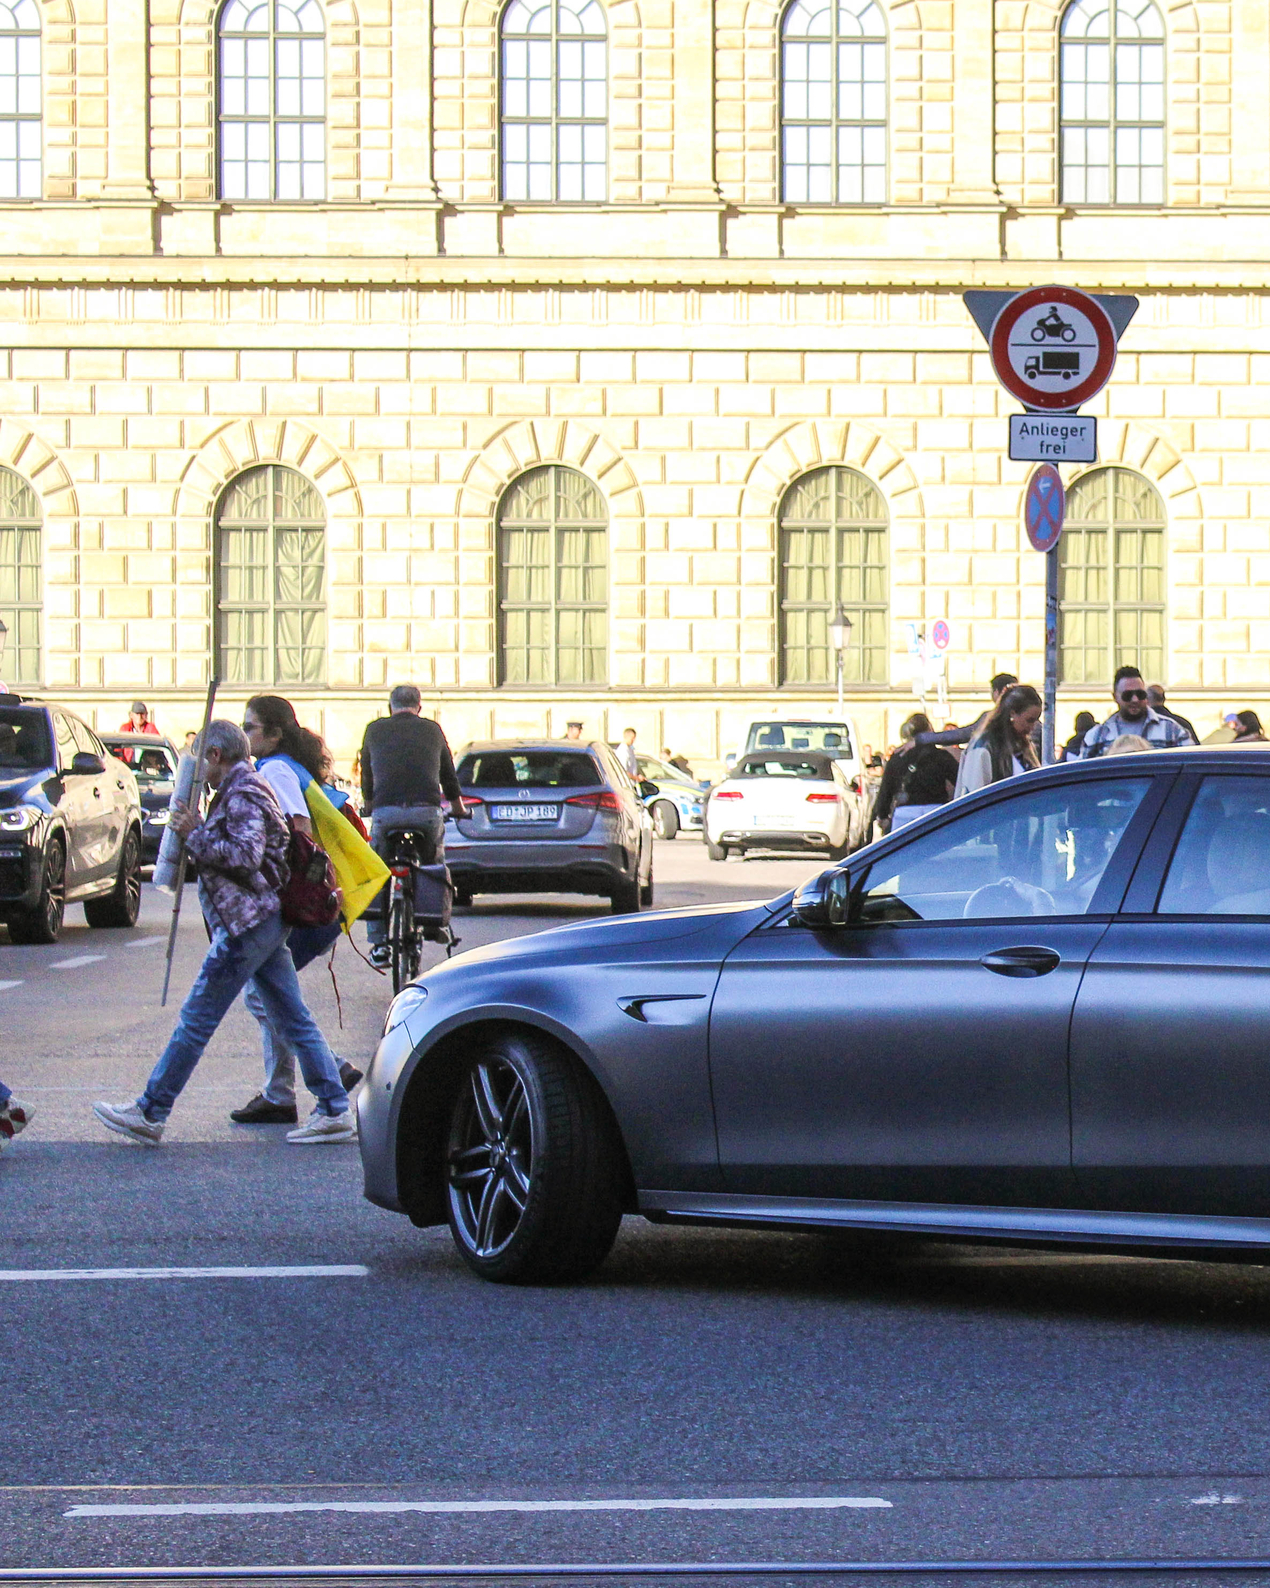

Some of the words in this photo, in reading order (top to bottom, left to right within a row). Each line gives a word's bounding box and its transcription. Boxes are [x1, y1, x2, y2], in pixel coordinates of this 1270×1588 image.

[1019, 422, 1087, 440] Anlieger
[1040, 440, 1066, 455] frei
[520, 806, 533, 818] JP
